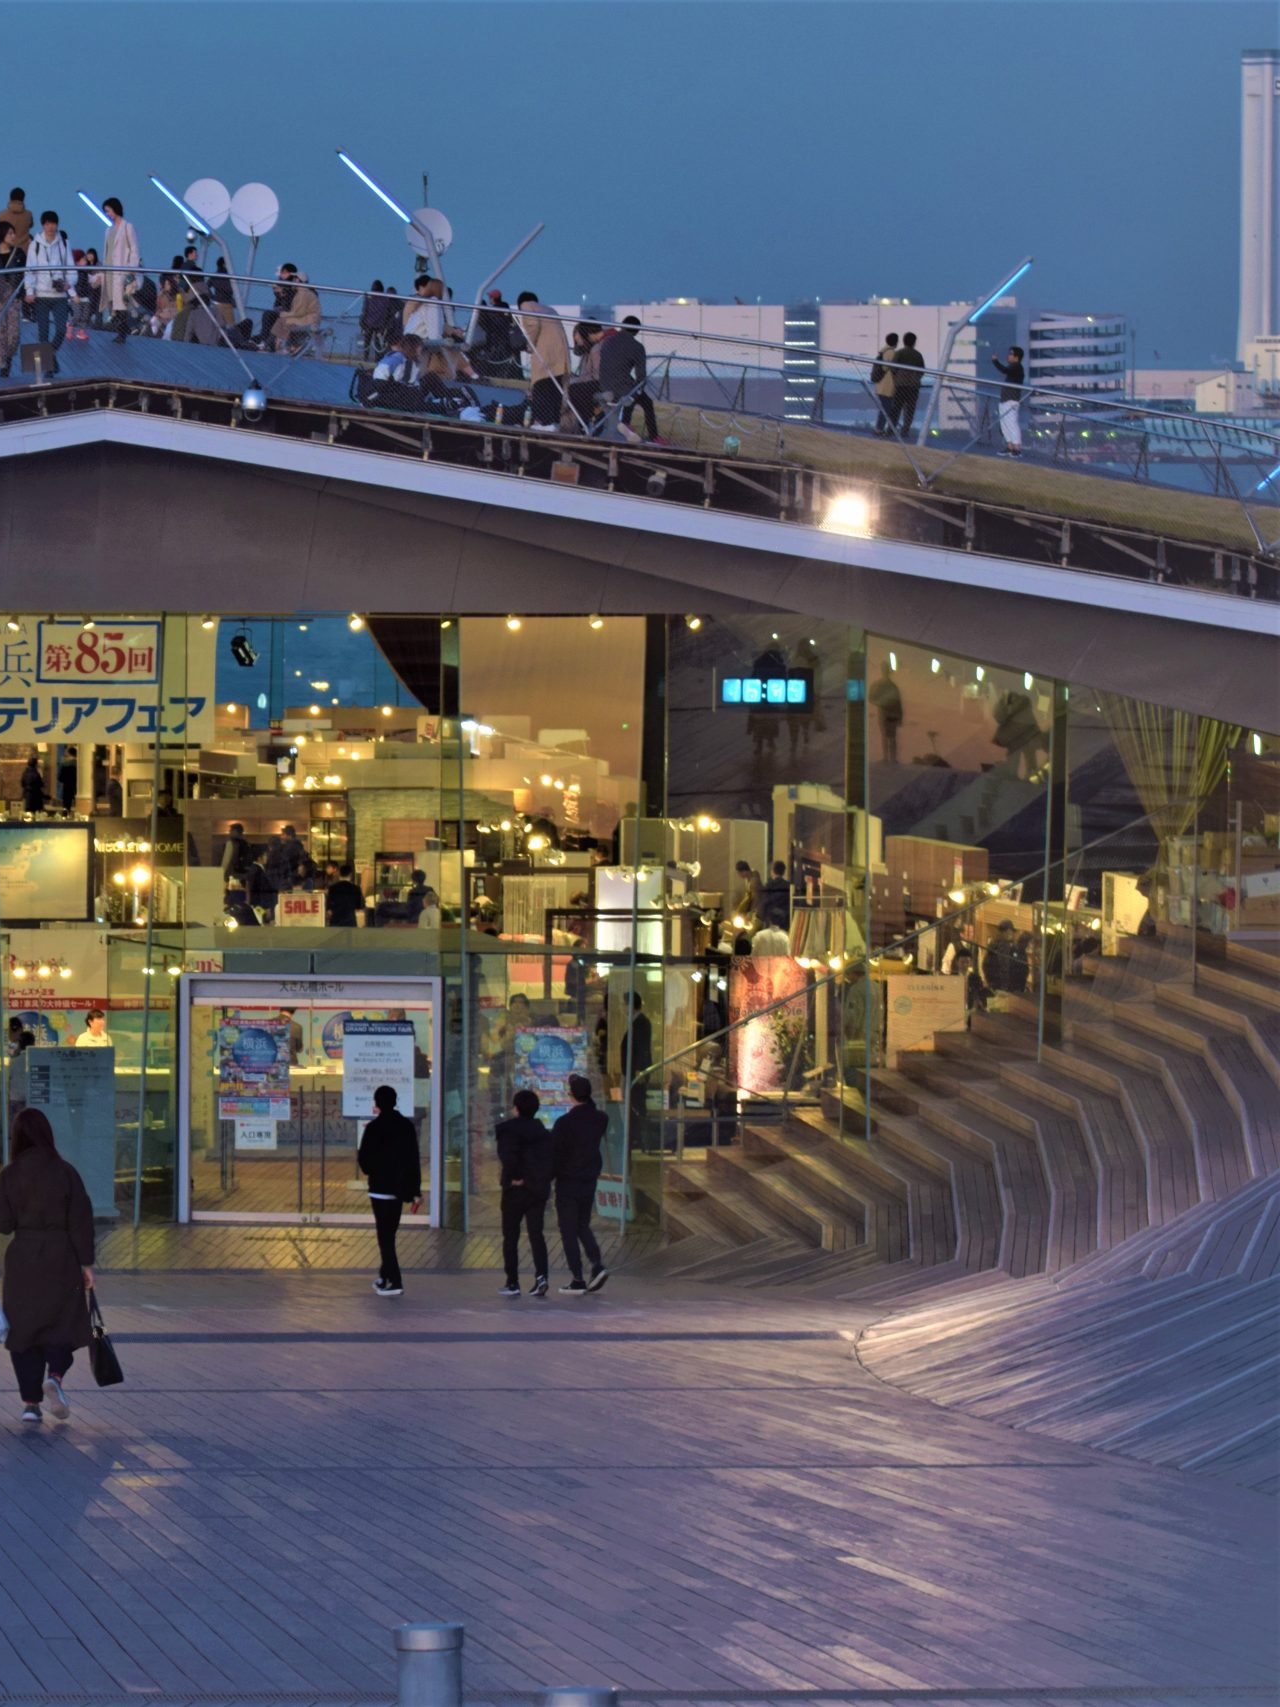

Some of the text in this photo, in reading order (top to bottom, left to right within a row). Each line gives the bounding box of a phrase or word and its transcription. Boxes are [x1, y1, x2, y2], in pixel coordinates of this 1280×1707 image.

[45, 631, 154, 674] 第85回
[284, 900, 319, 914] SALE
[242, 1037, 267, 1050] 横浜
[539, 1044, 564, 1058] 横浜
[240, 1130, 271, 1140] 入口専用
